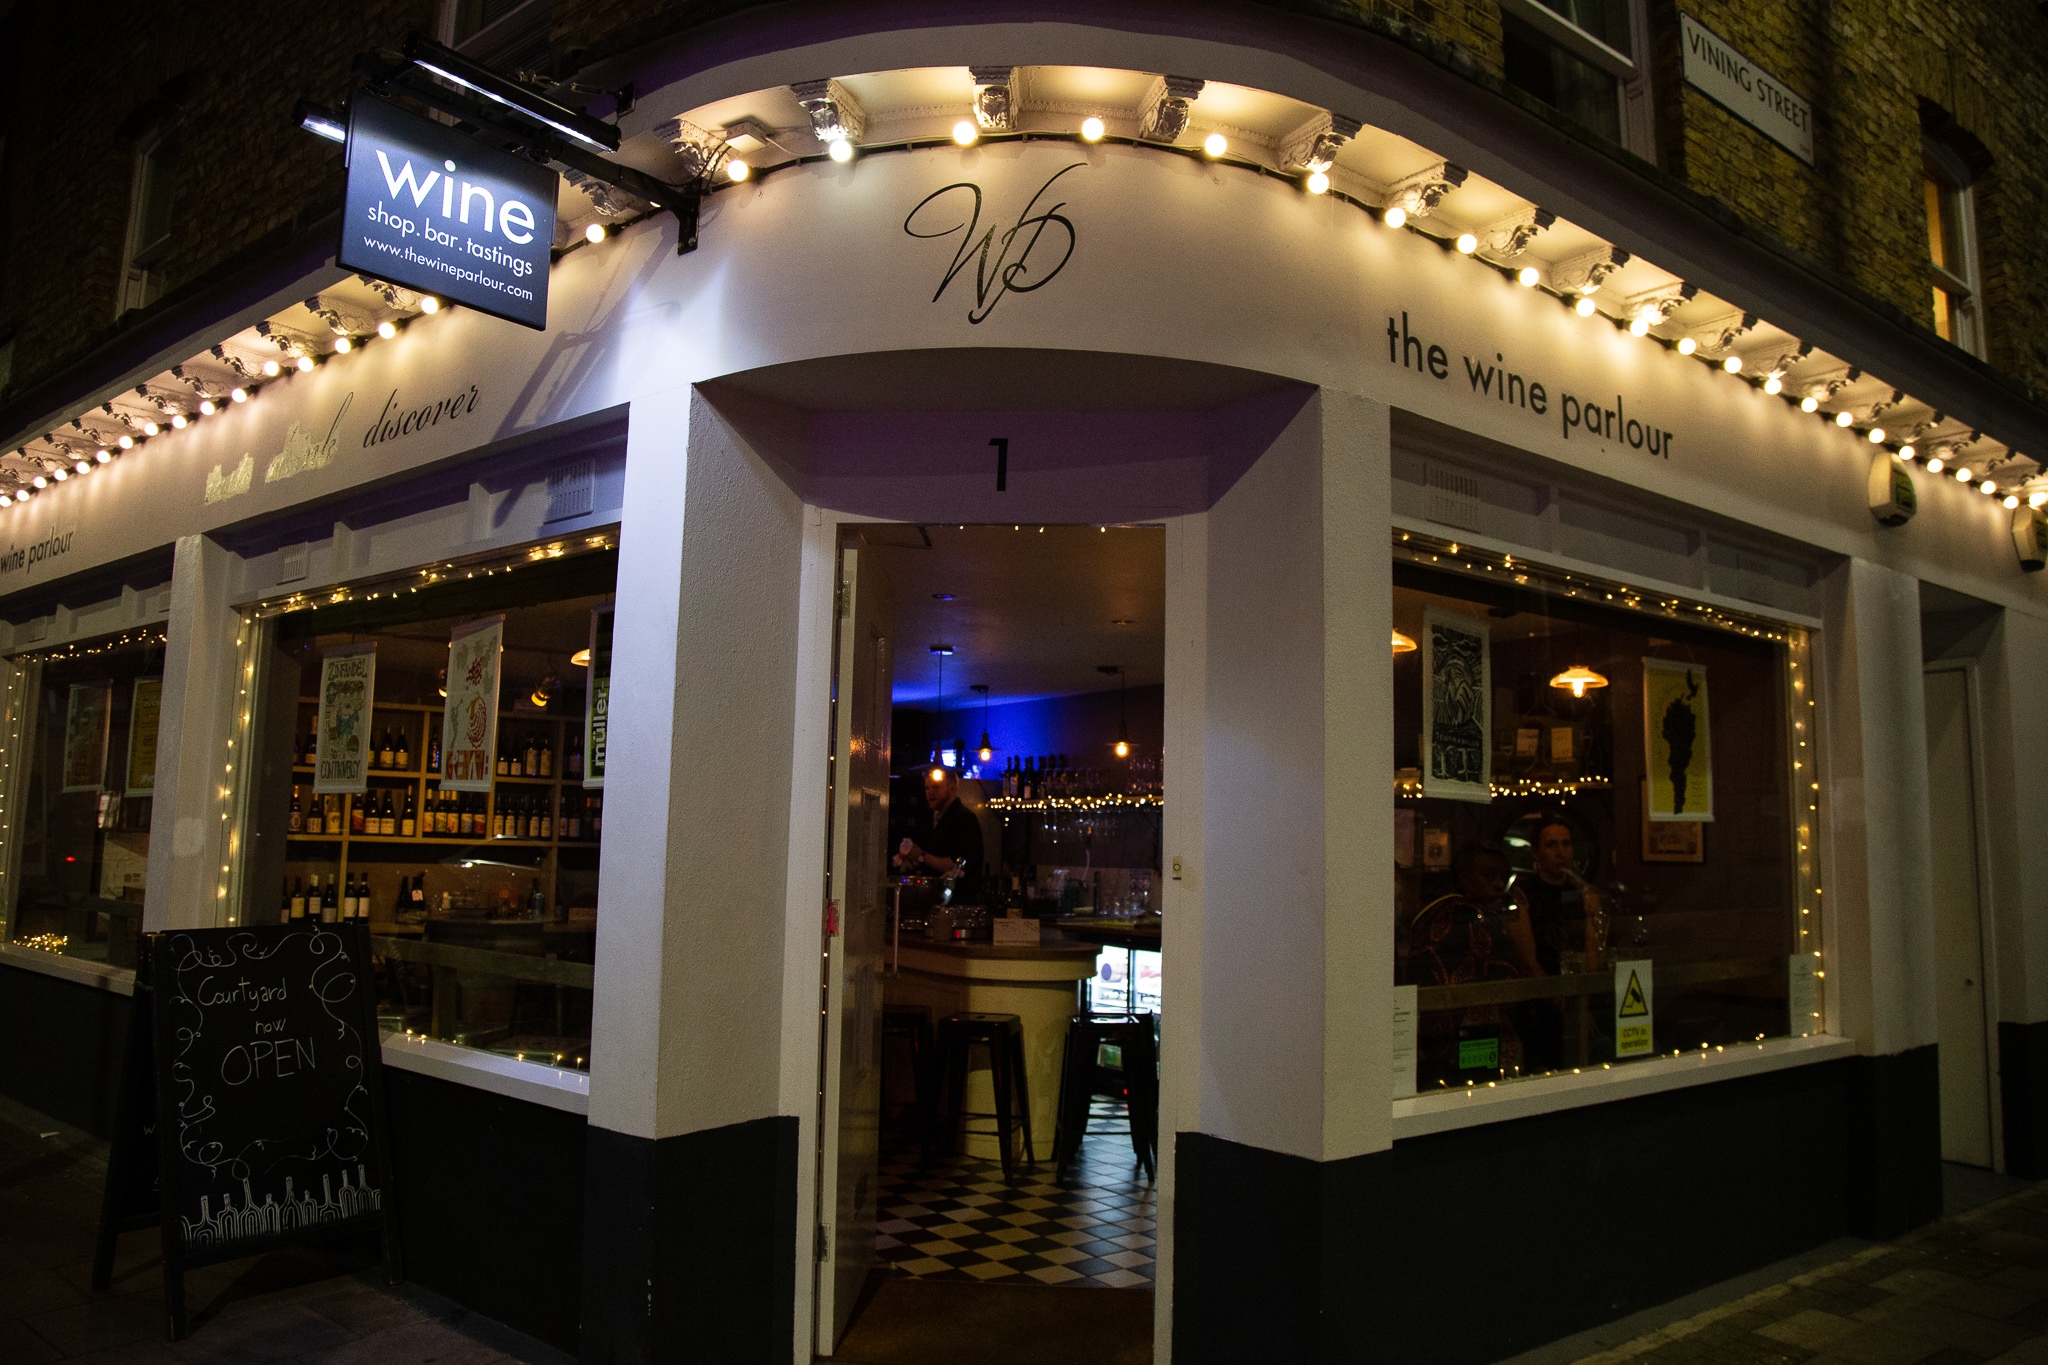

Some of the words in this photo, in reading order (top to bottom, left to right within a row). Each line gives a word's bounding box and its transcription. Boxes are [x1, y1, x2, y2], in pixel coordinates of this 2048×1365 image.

[1687, 27, 1752, 93] VINING
[1756, 79, 1808, 132] STREET
[376, 149, 535, 245] wine
[363, 236, 534, 301] www.thewineparlour.com
[466, 237, 533, 277] tastings
[1387, 311, 1449, 380] the
[1463, 352, 1548, 415] wine
[1561, 394, 1673, 460] parlour
[362, 384, 481, 449] discover
[988, 438, 1009, 492] 1
[0, 544, 26, 574] wine
[27, 525, 74, 575] parlour
[197, 975, 287, 1011] Courtyard
[255, 1018, 287, 1036] now
[221, 1037, 316, 1086] OPEN
